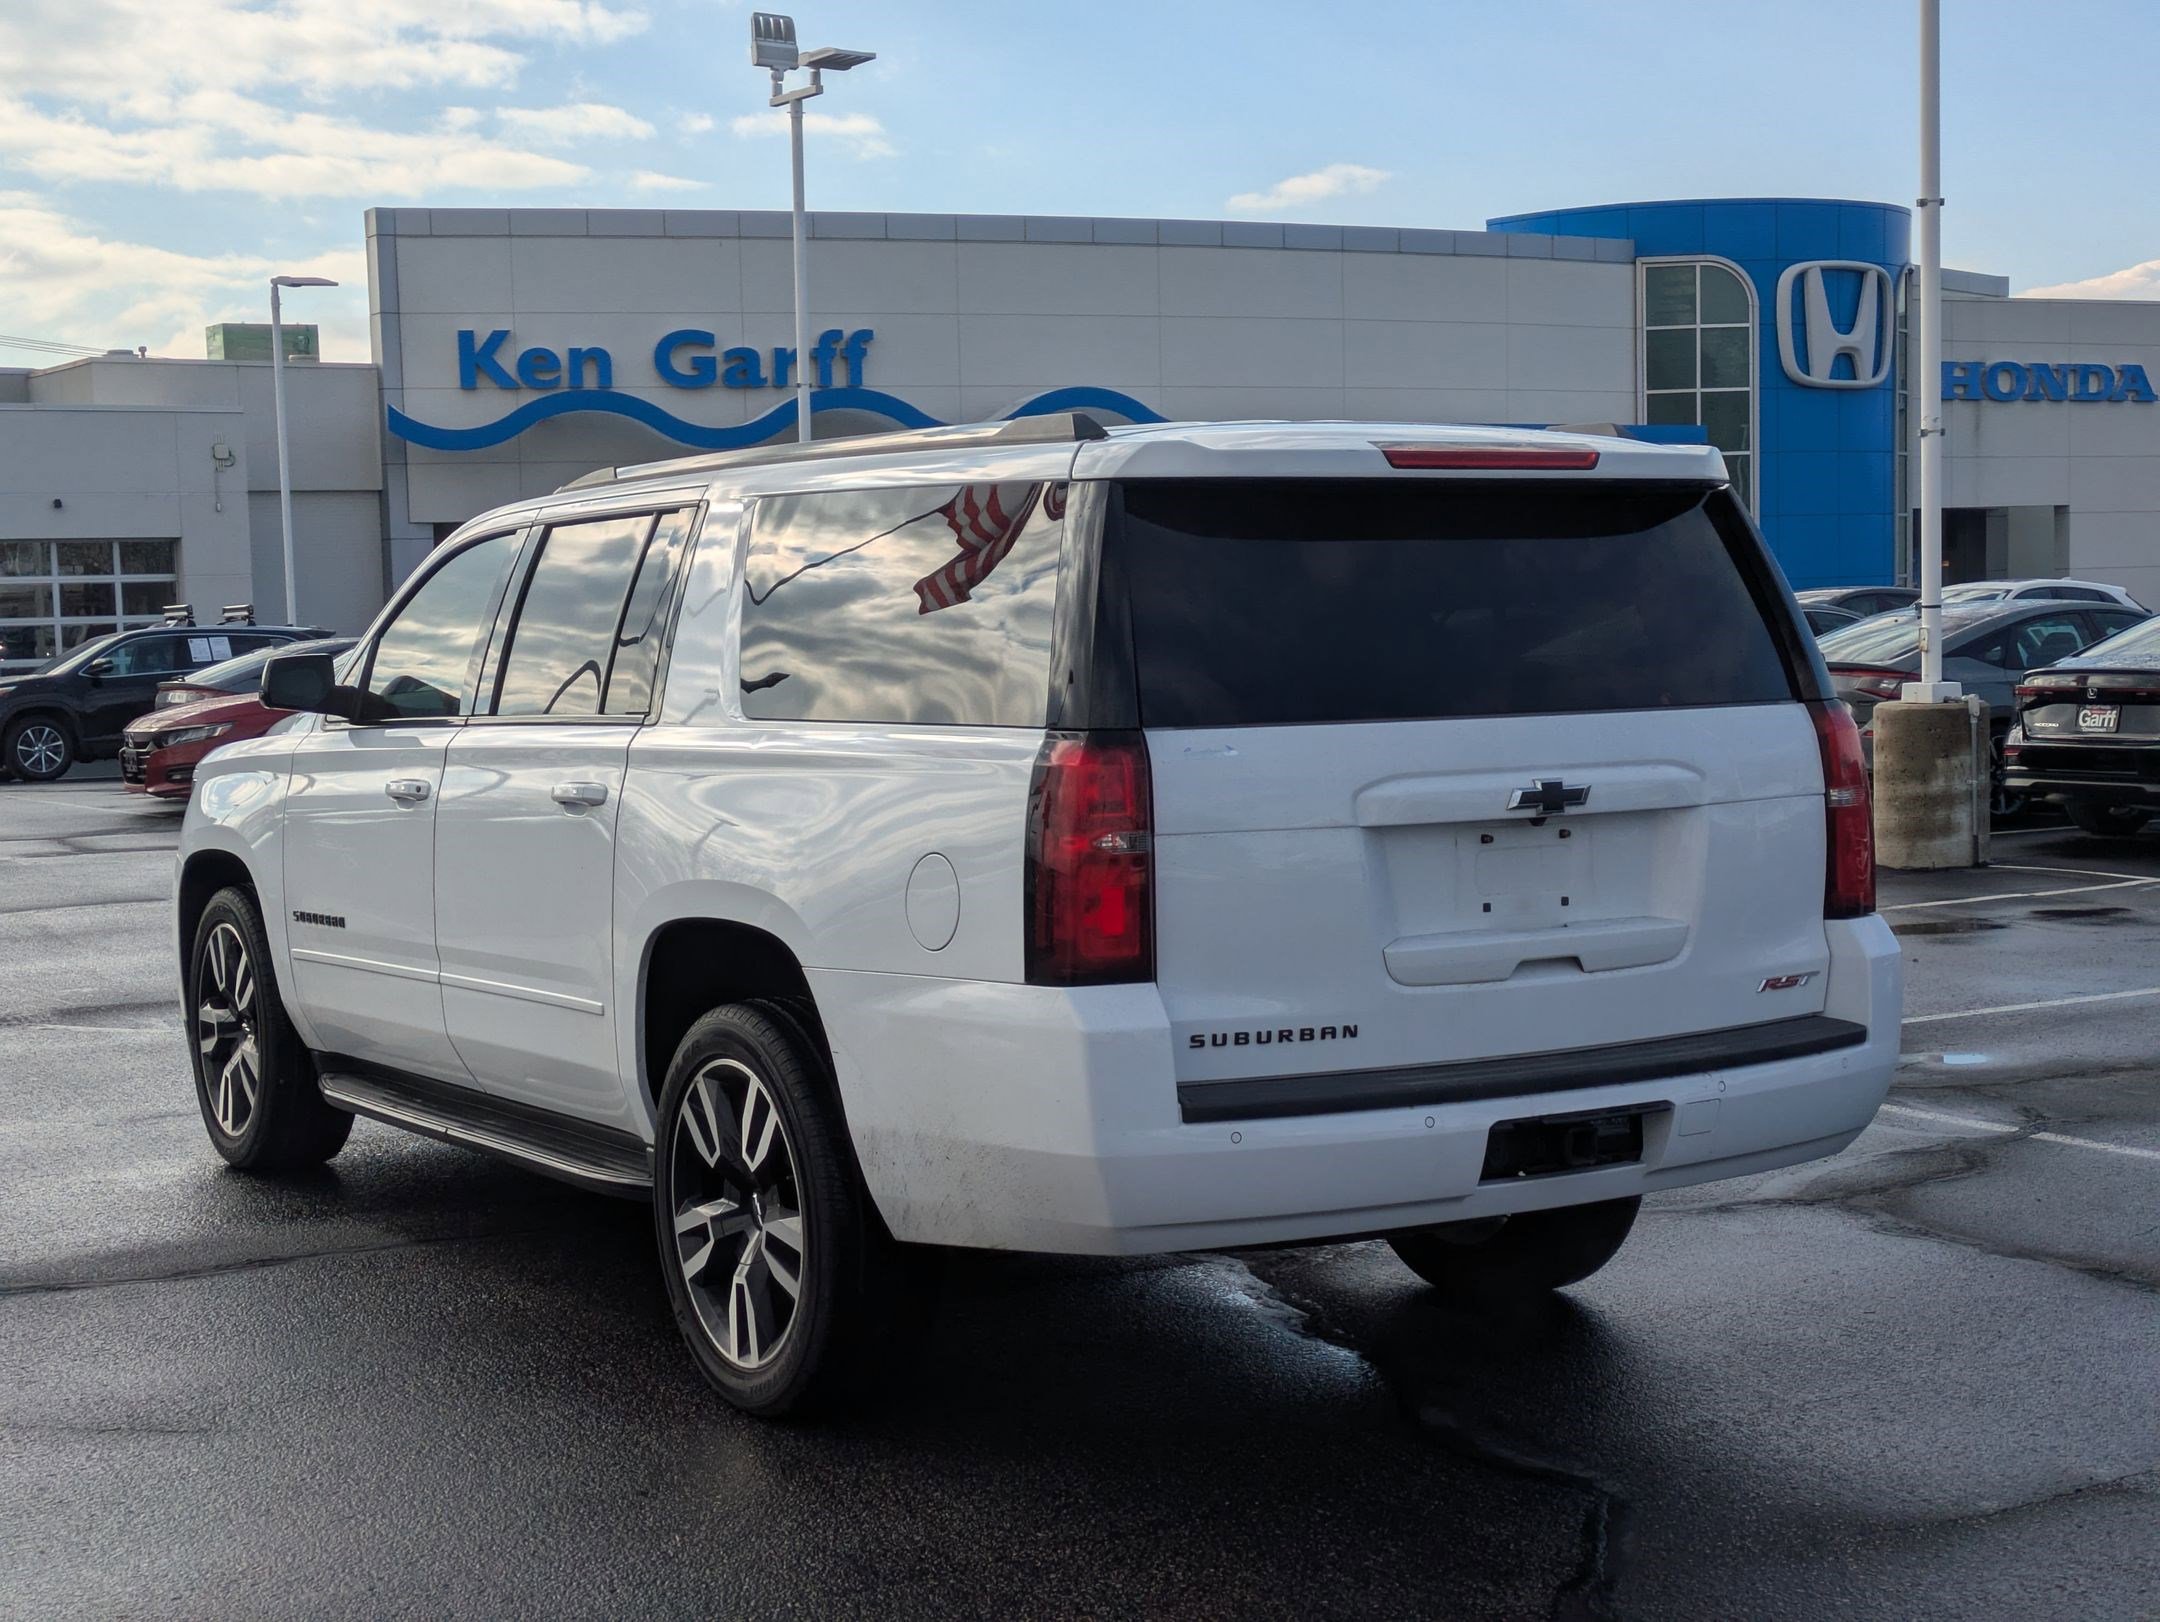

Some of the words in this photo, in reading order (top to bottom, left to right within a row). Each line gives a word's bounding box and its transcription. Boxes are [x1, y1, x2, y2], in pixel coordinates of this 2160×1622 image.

[457, 329, 613, 391] Ken
[653, 329, 875, 390] Garff
[1941, 360, 2159, 402] HONDA
[2078, 709, 2117, 727] Garff
[1189, 1024, 1359, 1049] SUBURBAN
